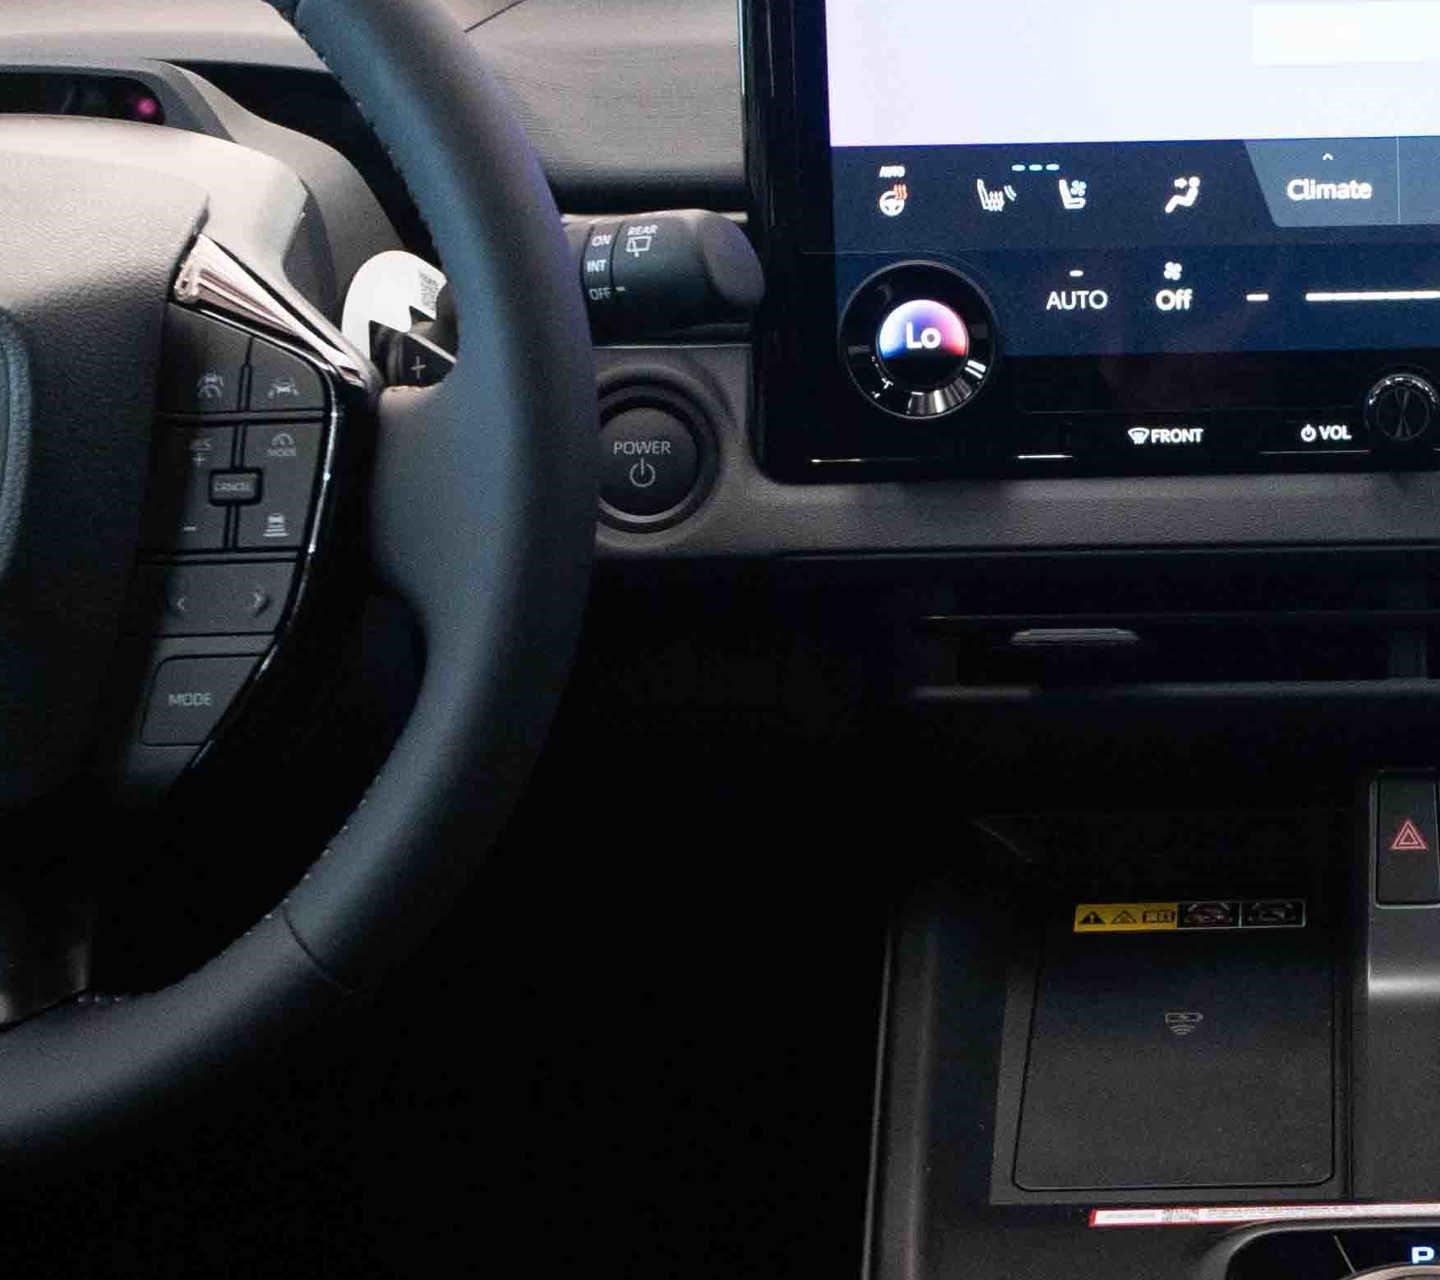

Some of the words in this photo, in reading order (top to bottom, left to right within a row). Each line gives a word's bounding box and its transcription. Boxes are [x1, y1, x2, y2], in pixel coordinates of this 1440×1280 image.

[879, 165, 906, 178] AUTO
[1286, 178, 1373, 202] Climate
[627, 224, 658, 236] REAR
[592, 234, 612, 247] ON
[587, 259, 607, 273] INT
[588, 287, 612, 302] OFF
[1046, 289, 1110, 311] AUTO
[1155, 289, 1194, 311] Off
[905, 321, 941, 350] Lo
[1150, 428, 1203, 443] FRONT
[1319, 425, 1352, 440] VOL
[613, 440, 672, 456] POWER
[168, 691, 212, 707] MODE
[1411, 1246, 1435, 1264] P
